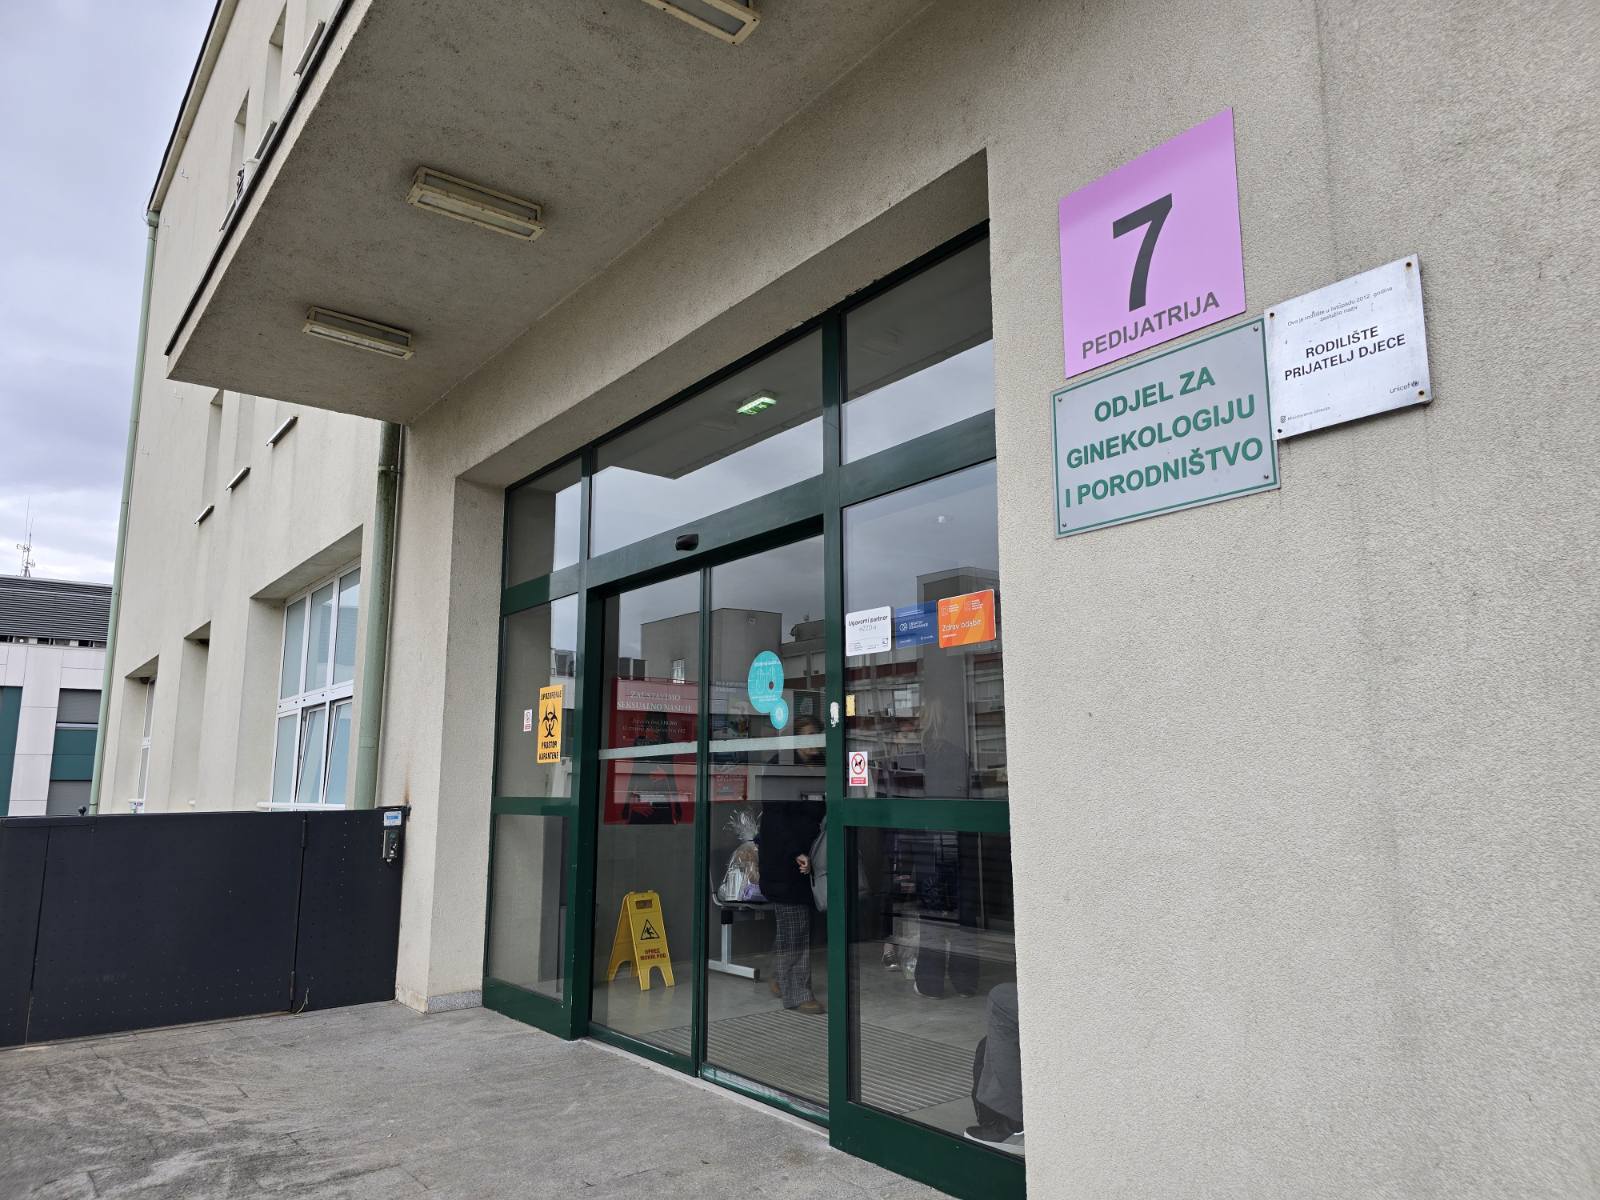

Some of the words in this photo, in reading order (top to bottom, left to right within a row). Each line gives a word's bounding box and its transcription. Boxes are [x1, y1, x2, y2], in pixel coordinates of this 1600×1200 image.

[1112, 193, 1173, 312] 7
[1082, 291, 1220, 359] PEDIJATRIJA
[1305, 325, 1379, 359] RODILIŠTE
[1284, 354, 1354, 381] PRIJATELJ
[1359, 334, 1406, 359] DJECE
[1389, 382, 1411, 394] unicef
[1094, 380, 1174, 423] ODJEL
[1179, 366, 1216, 393] ZA
[1066, 394, 1256, 469] GINEKOLOGIJU
[1065, 488, 1071, 508] I
[1077, 437, 1264, 505] PORODNIŠTVO
